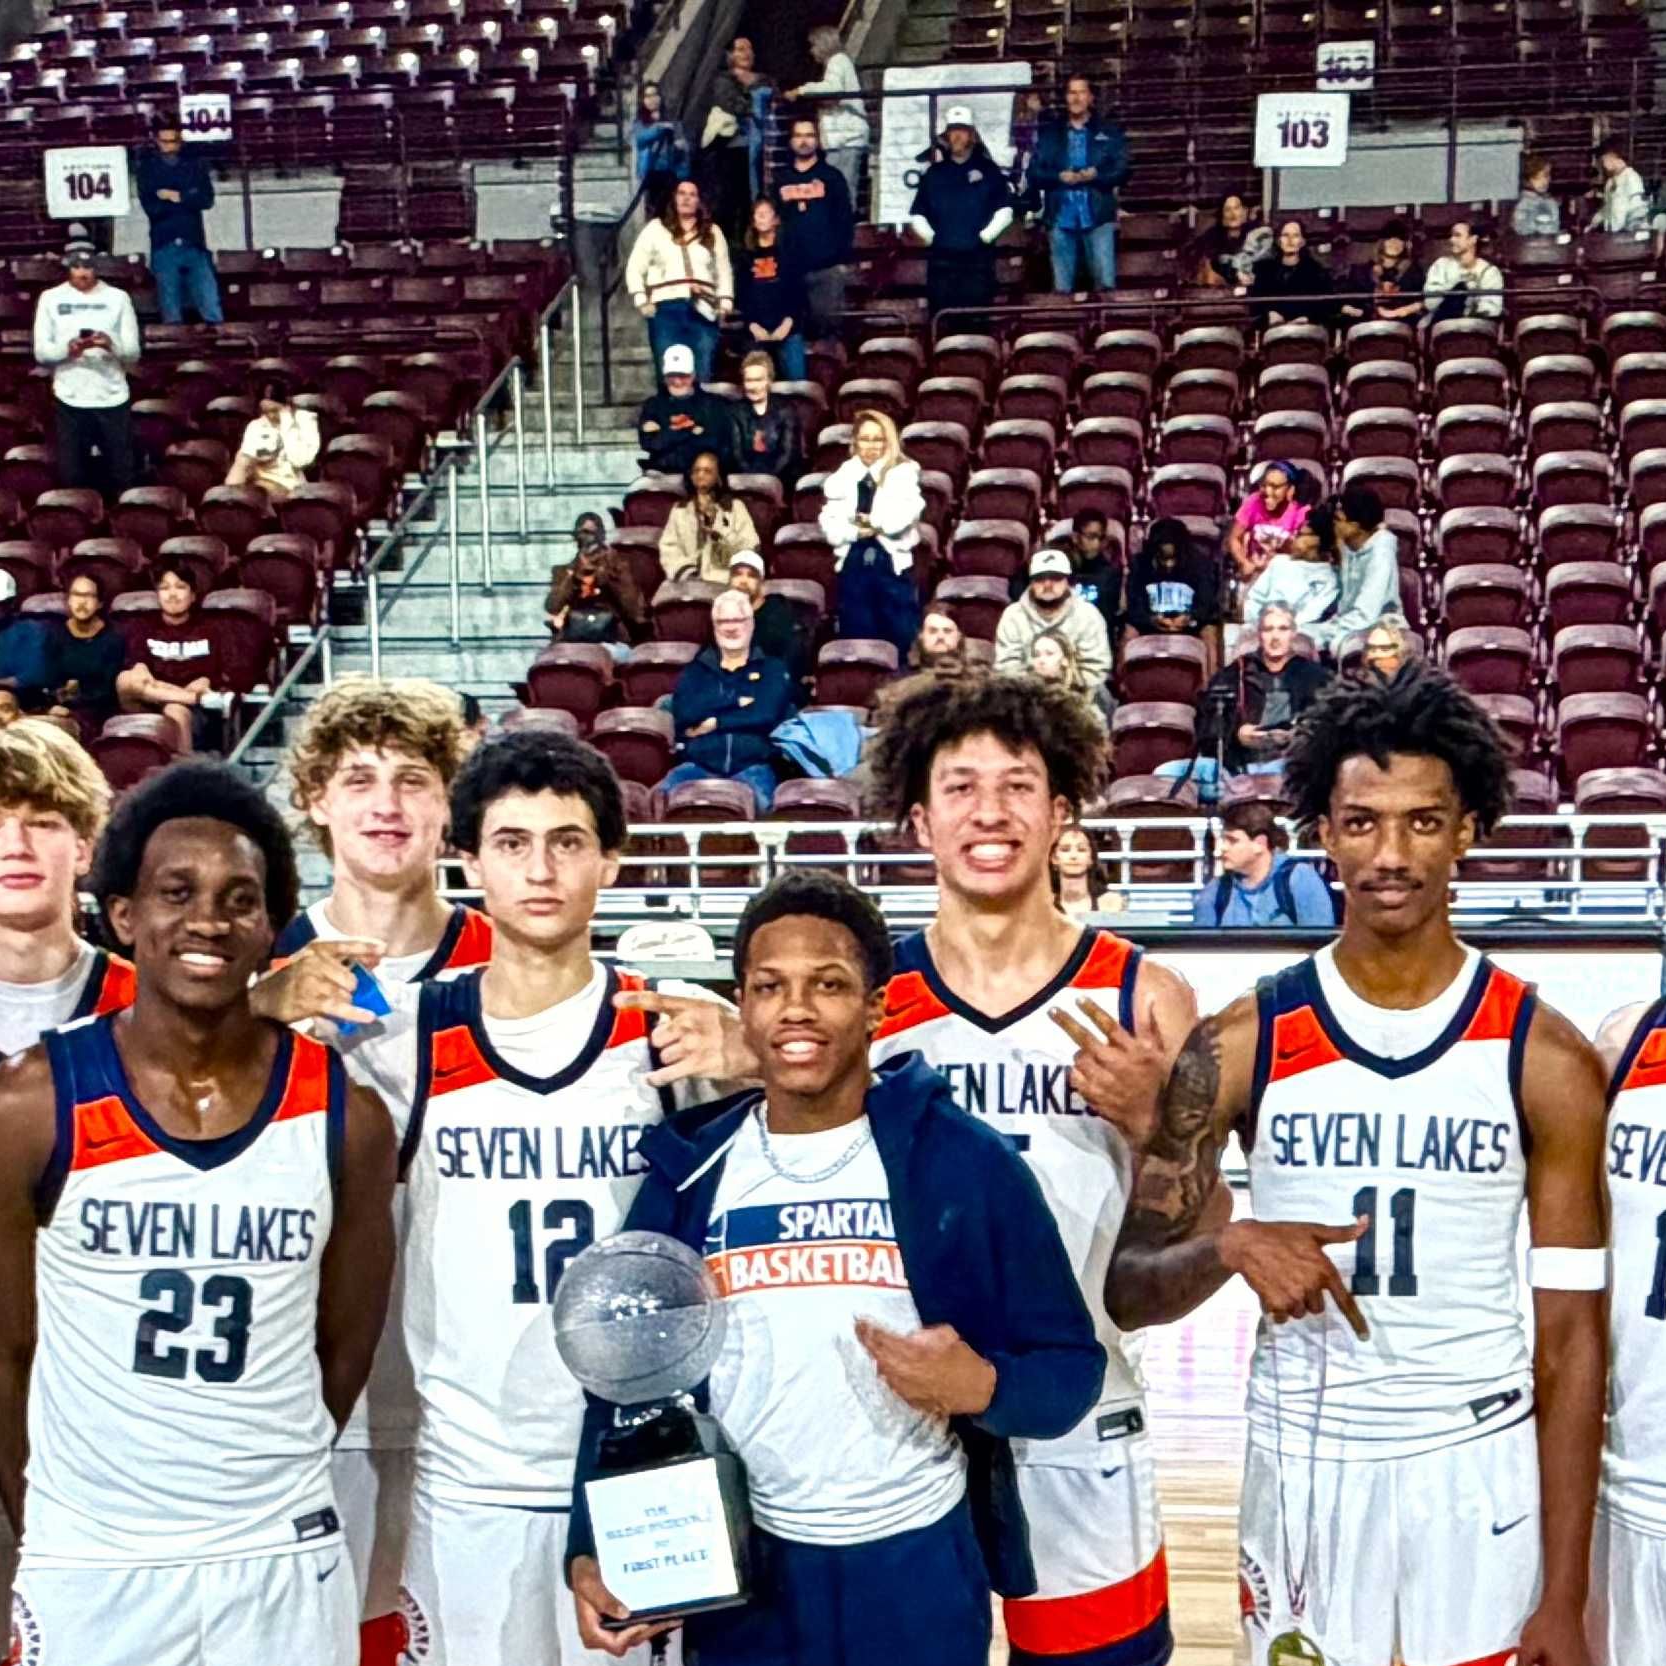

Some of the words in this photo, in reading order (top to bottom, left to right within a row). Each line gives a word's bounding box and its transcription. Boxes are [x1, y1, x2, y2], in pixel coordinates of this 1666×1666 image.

[1277, 119, 1329, 148] 103
[64, 172, 113, 200] 104
[998, 1062, 1101, 1116] LAKE
[436, 1126, 542, 1179] SEVEN
[555, 1126, 651, 1178] LAKE
[1271, 1113, 1381, 1166] SEVEN
[1396, 1114, 1510, 1173] LAKES
[81, 1198, 196, 1259] SEVEN
[211, 1204, 317, 1262] LAKES
[509, 1200, 595, 1304] 12
[1351, 1186, 1418, 1296] 11
[730, 1247, 909, 1290] BASKETBAL
[134, 1269, 253, 1383] 23
